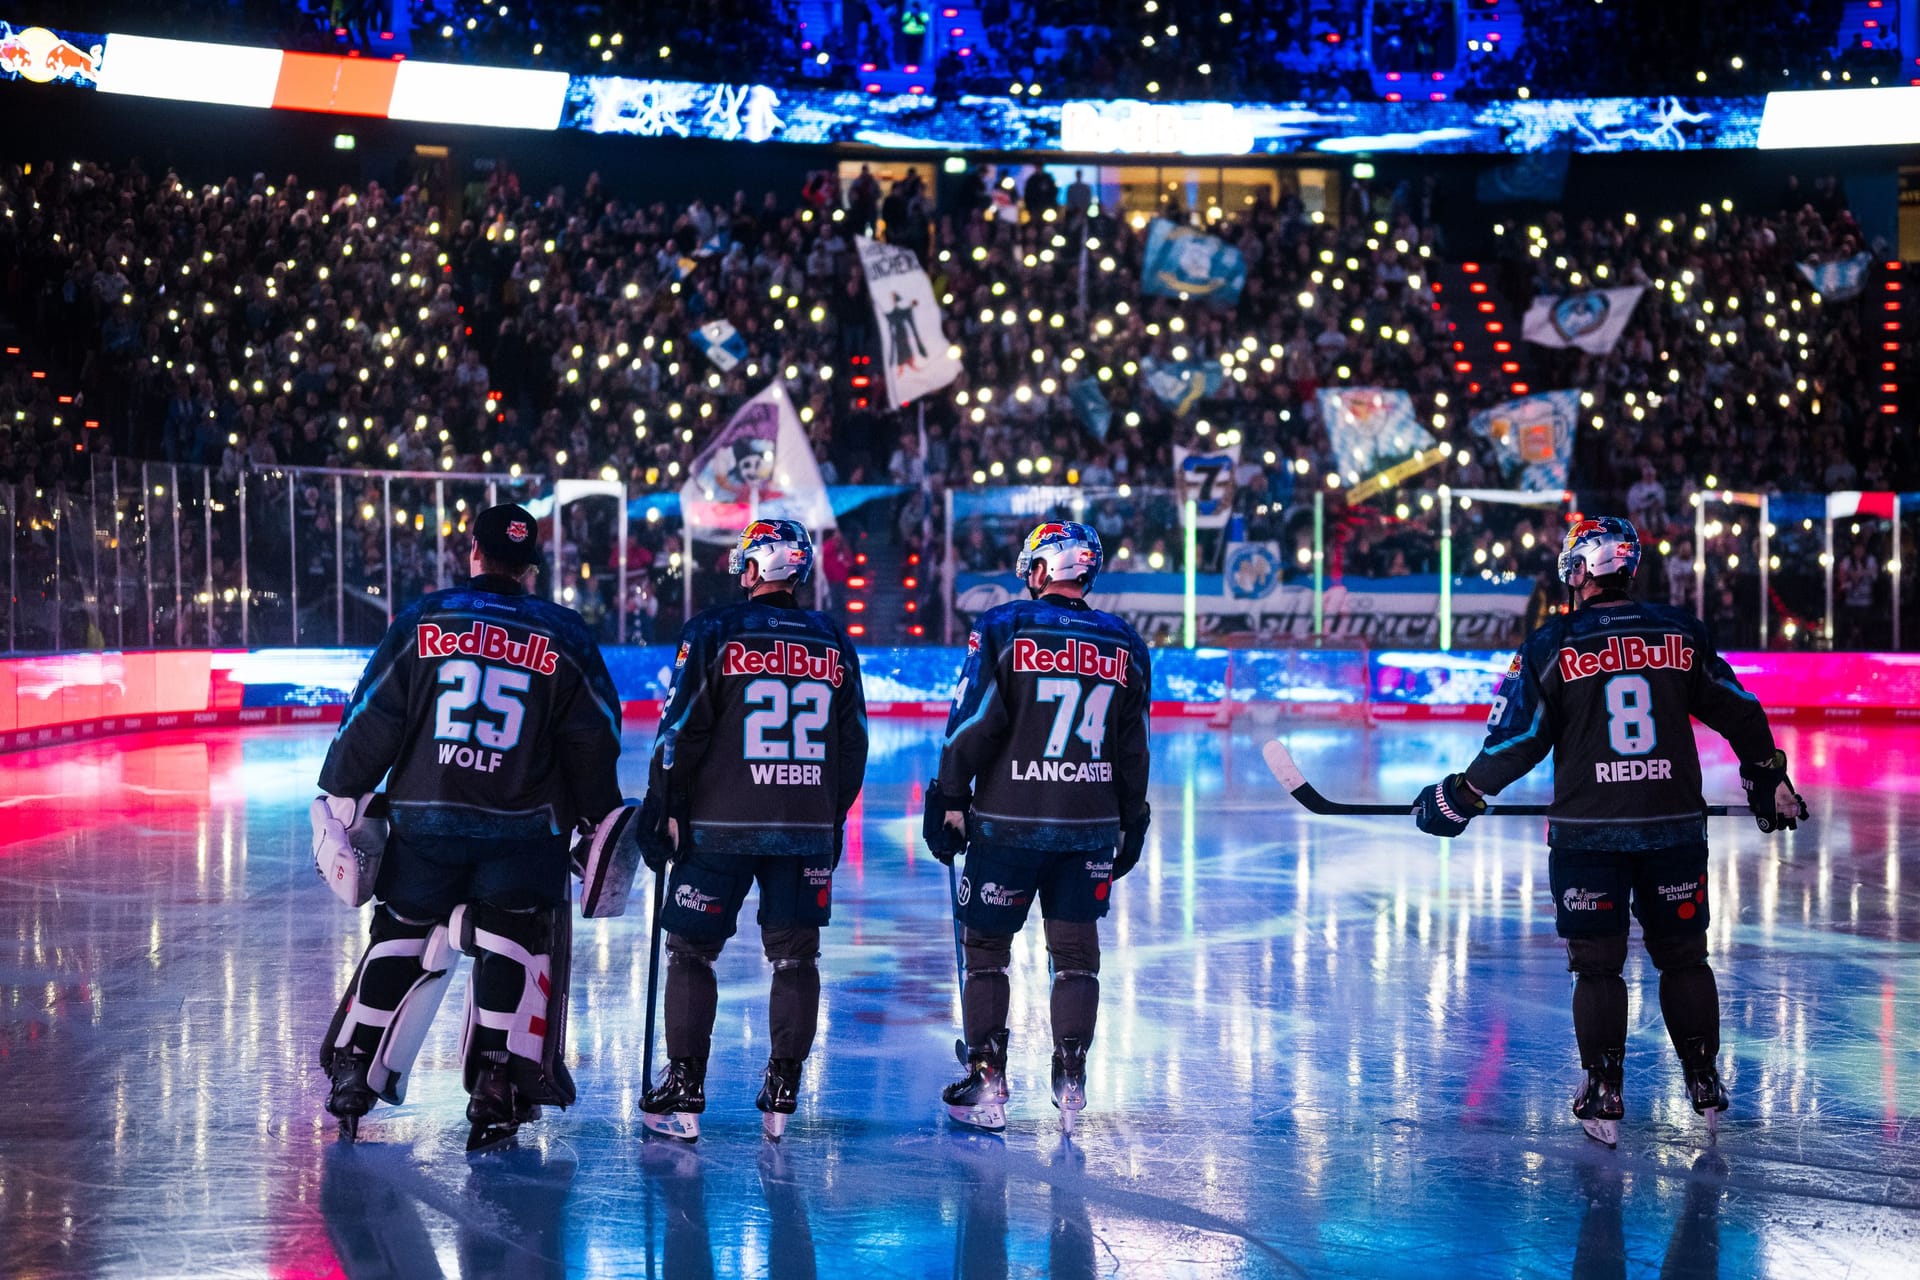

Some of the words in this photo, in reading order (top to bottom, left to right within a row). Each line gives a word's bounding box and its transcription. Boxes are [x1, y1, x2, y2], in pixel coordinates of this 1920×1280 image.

[434, 659, 531, 751] 25
[743, 679, 832, 761] 22
[1036, 677, 1116, 760] 74
[1487, 694, 1508, 726] 8
[1604, 674, 1657, 756] 8
[438, 743, 503, 773] WOLF
[1011, 760, 1112, 783] LANCASTER
[1595, 759, 1672, 783] RIEDER
[750, 764, 821, 786] WEBER
[1658, 882, 1698, 895] Schuller
